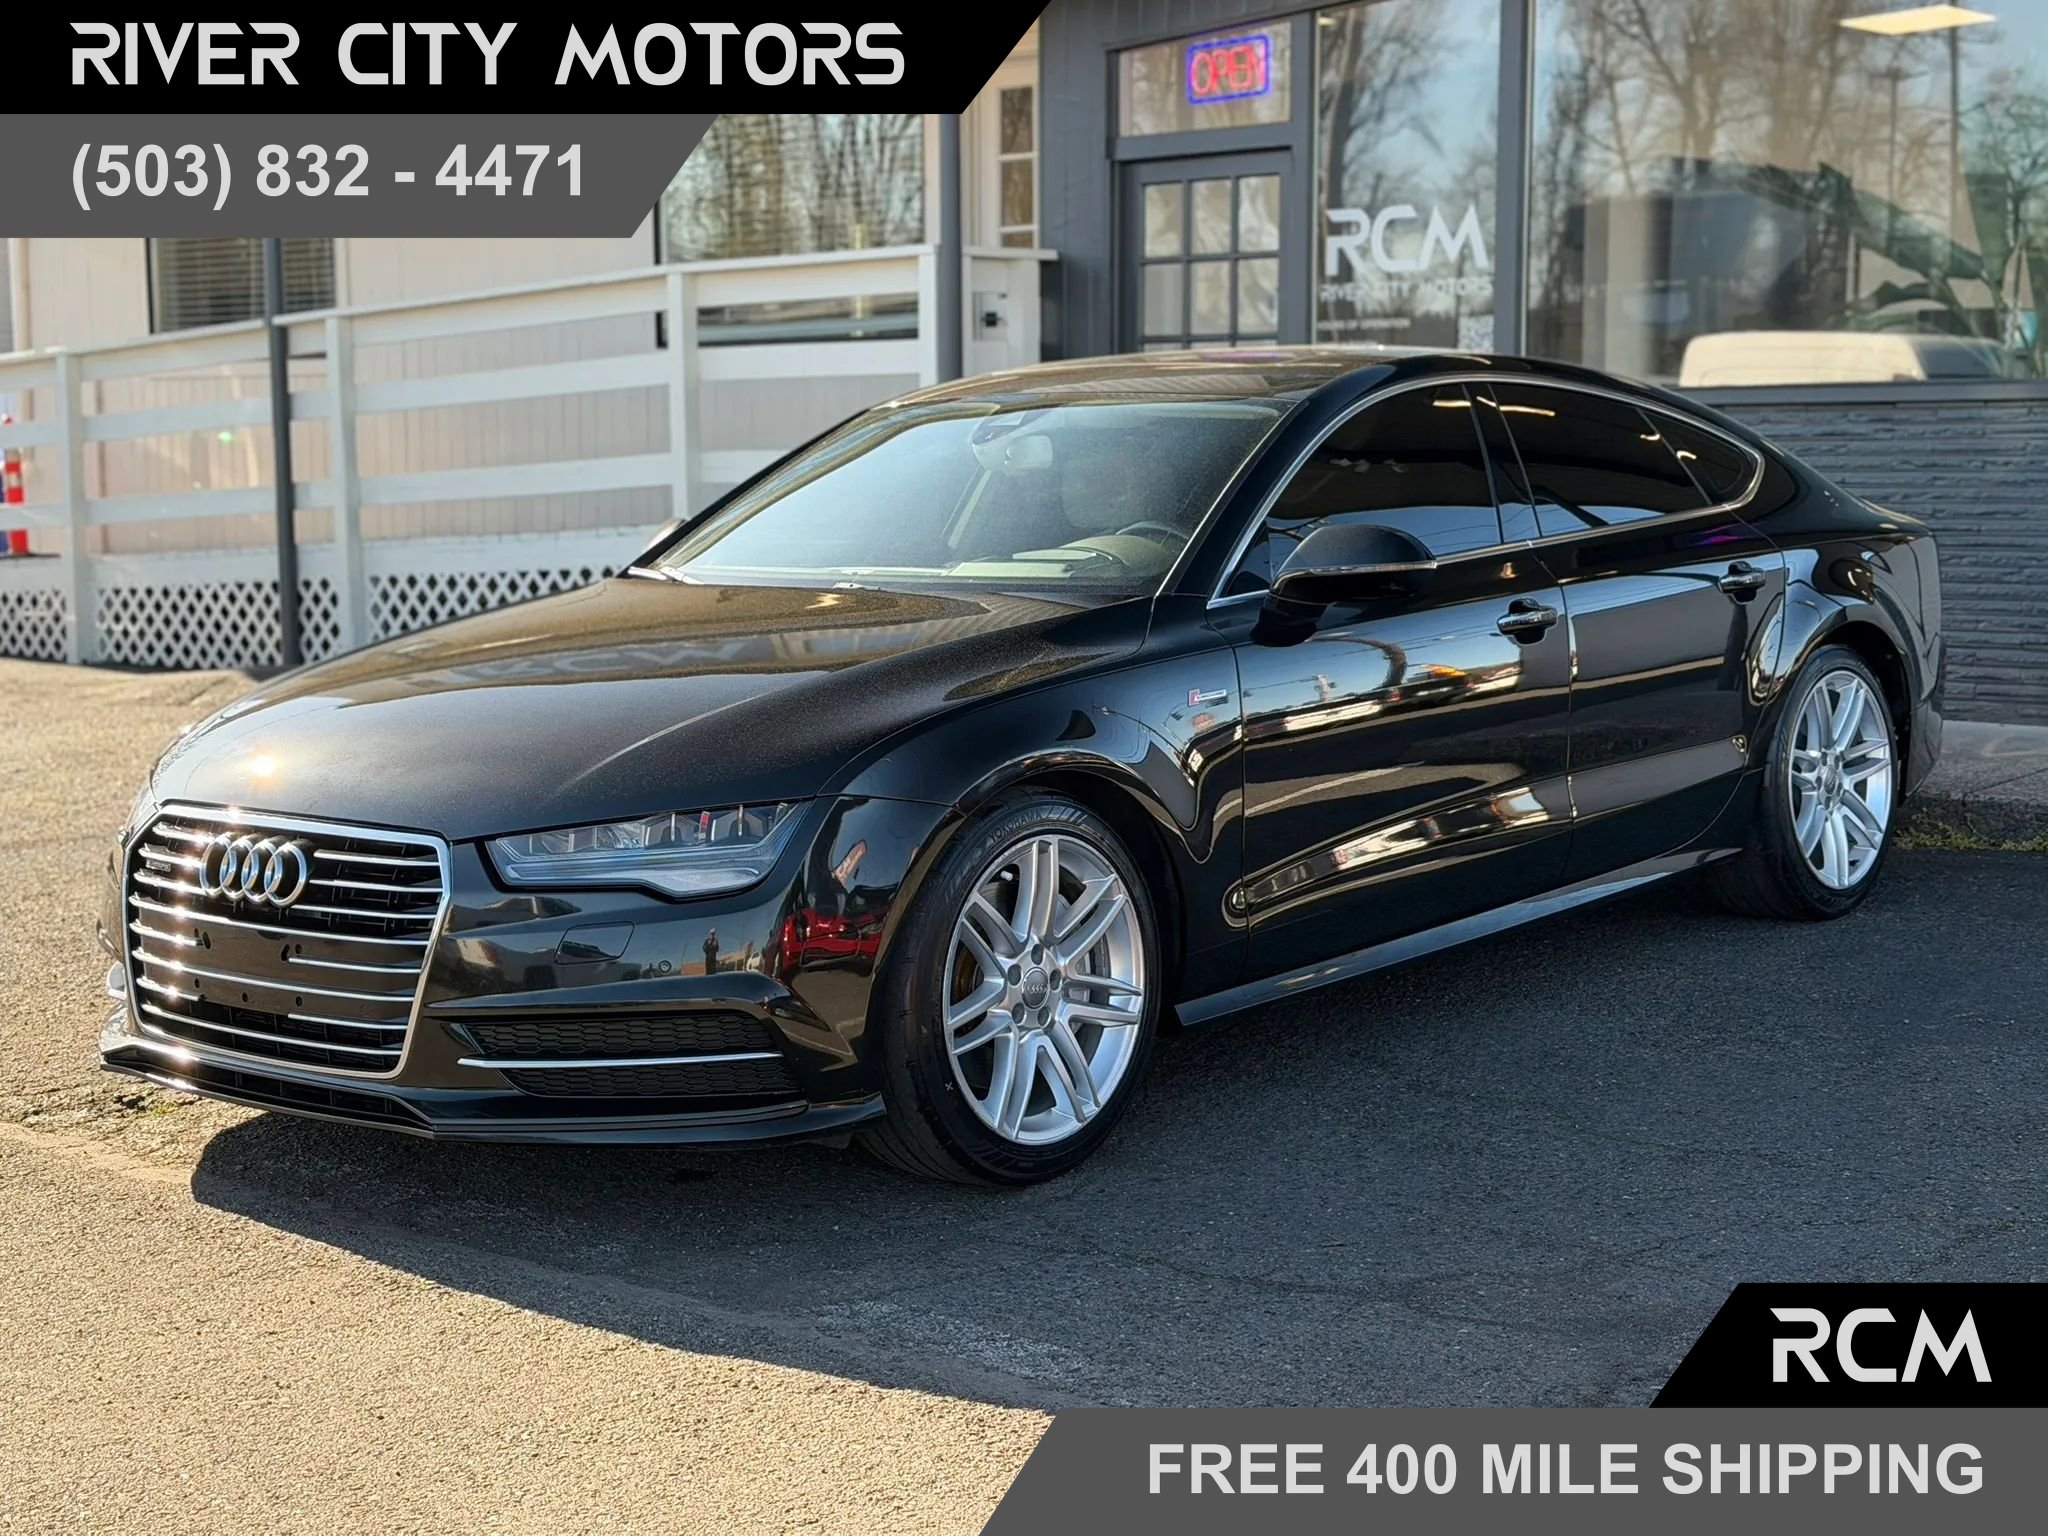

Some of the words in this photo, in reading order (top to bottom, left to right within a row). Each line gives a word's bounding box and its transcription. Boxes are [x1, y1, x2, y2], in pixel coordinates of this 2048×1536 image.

[1190, 44, 1265, 96] OPEN
[1325, 203, 1489, 277] RCM
[988, 808, 1043, 843] YOKOHAMA
